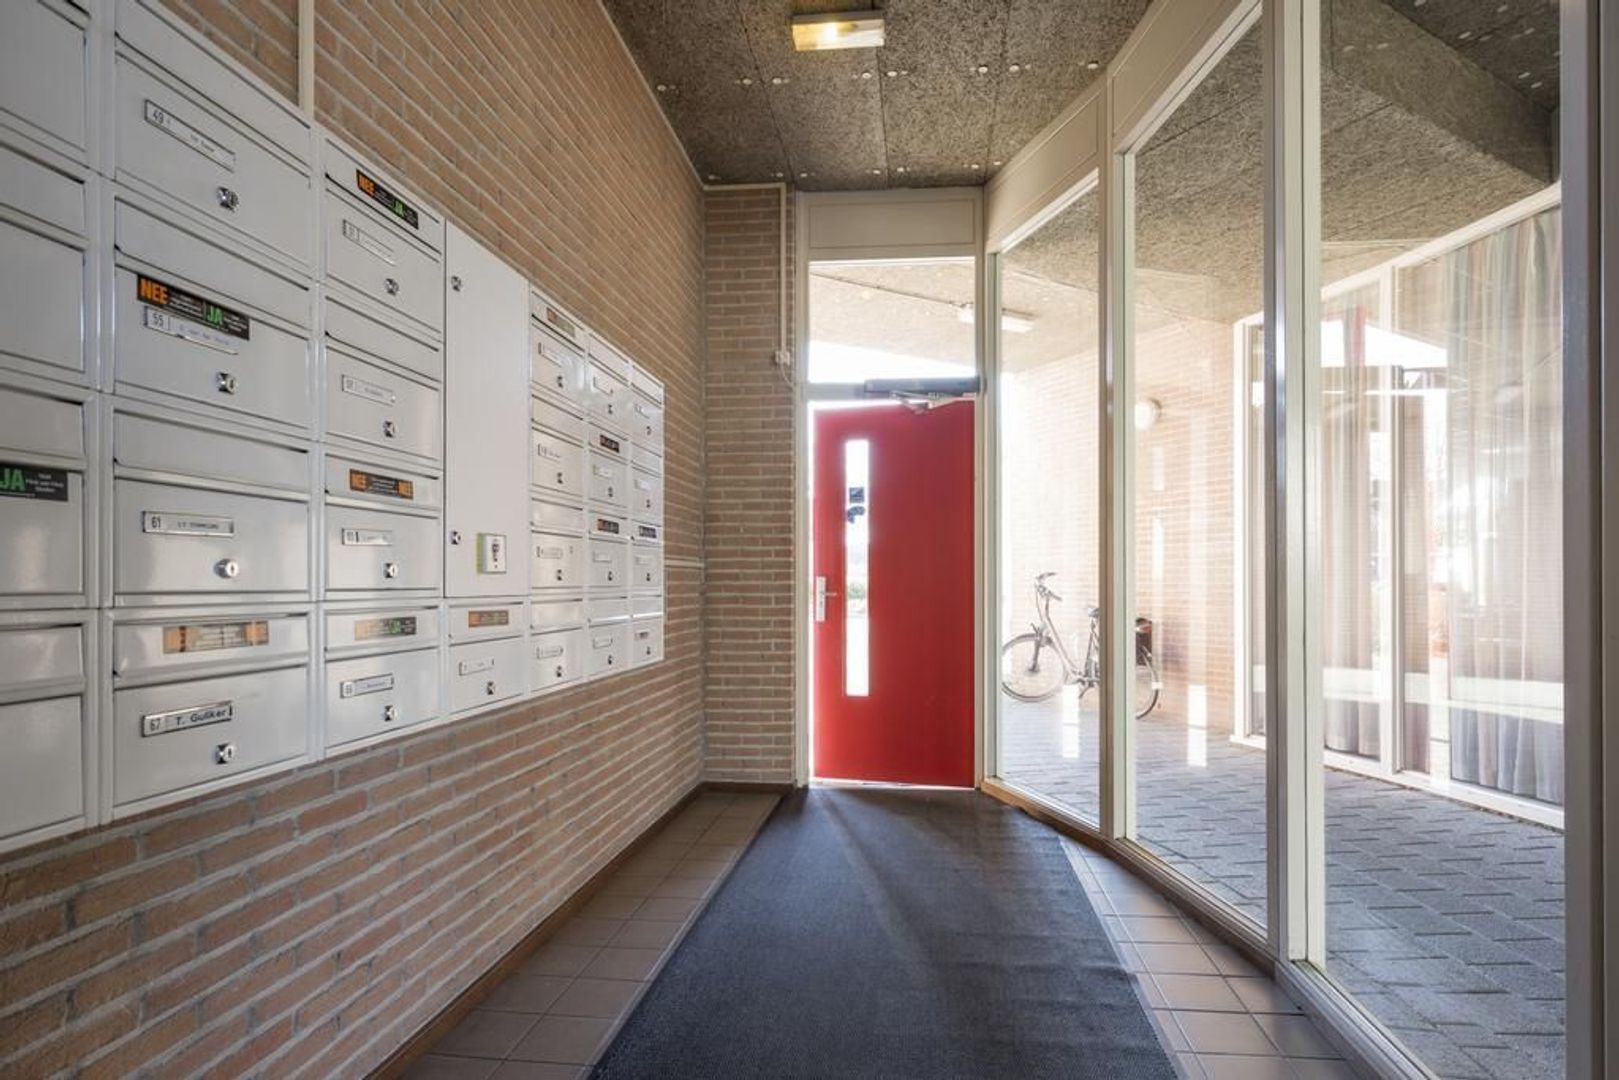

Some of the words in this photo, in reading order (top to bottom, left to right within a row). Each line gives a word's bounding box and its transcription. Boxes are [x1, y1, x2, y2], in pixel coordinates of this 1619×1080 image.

[140, 277, 169, 306] NEE
[153, 312, 164, 326] 55
[207, 304, 223, 326] JA
[0, 467, 26, 491] JA
[151, 515, 161, 529] 61
[176, 716, 186, 726] T.
